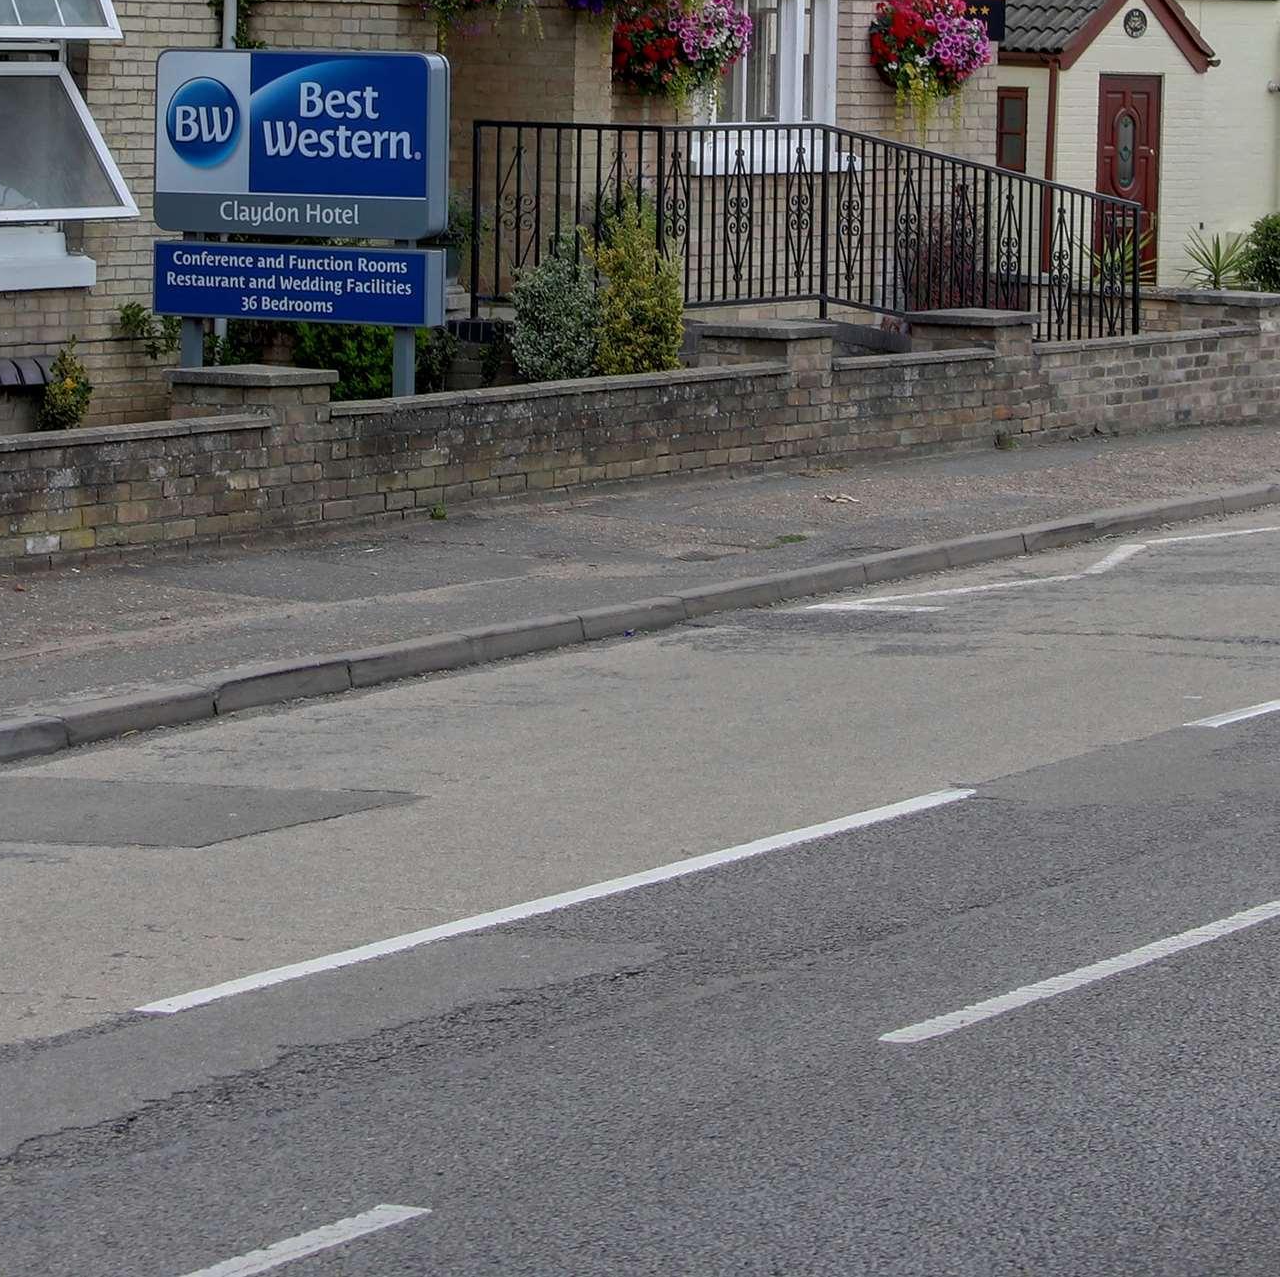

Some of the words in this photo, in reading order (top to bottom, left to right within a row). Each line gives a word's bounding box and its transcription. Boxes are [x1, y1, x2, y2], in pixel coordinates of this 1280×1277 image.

[299, 81, 379, 119] Best
[175, 105, 234, 143] BW
[219, 201, 299, 226] Claydon
[306, 203, 360, 225] Hotel
[172, 250, 254, 269] Conference
[257, 253, 284, 270] and
[289, 255, 354, 272] Function
[357, 257, 408, 274] Rooms
[166, 271, 246, 290] Restaurant
[249, 274, 276, 290] and
[279, 275, 343, 296] Wedding
[346, 277, 413, 296] Facilities
[240, 295, 258, 312] 36
[261, 296, 334, 314] Bedrooms
